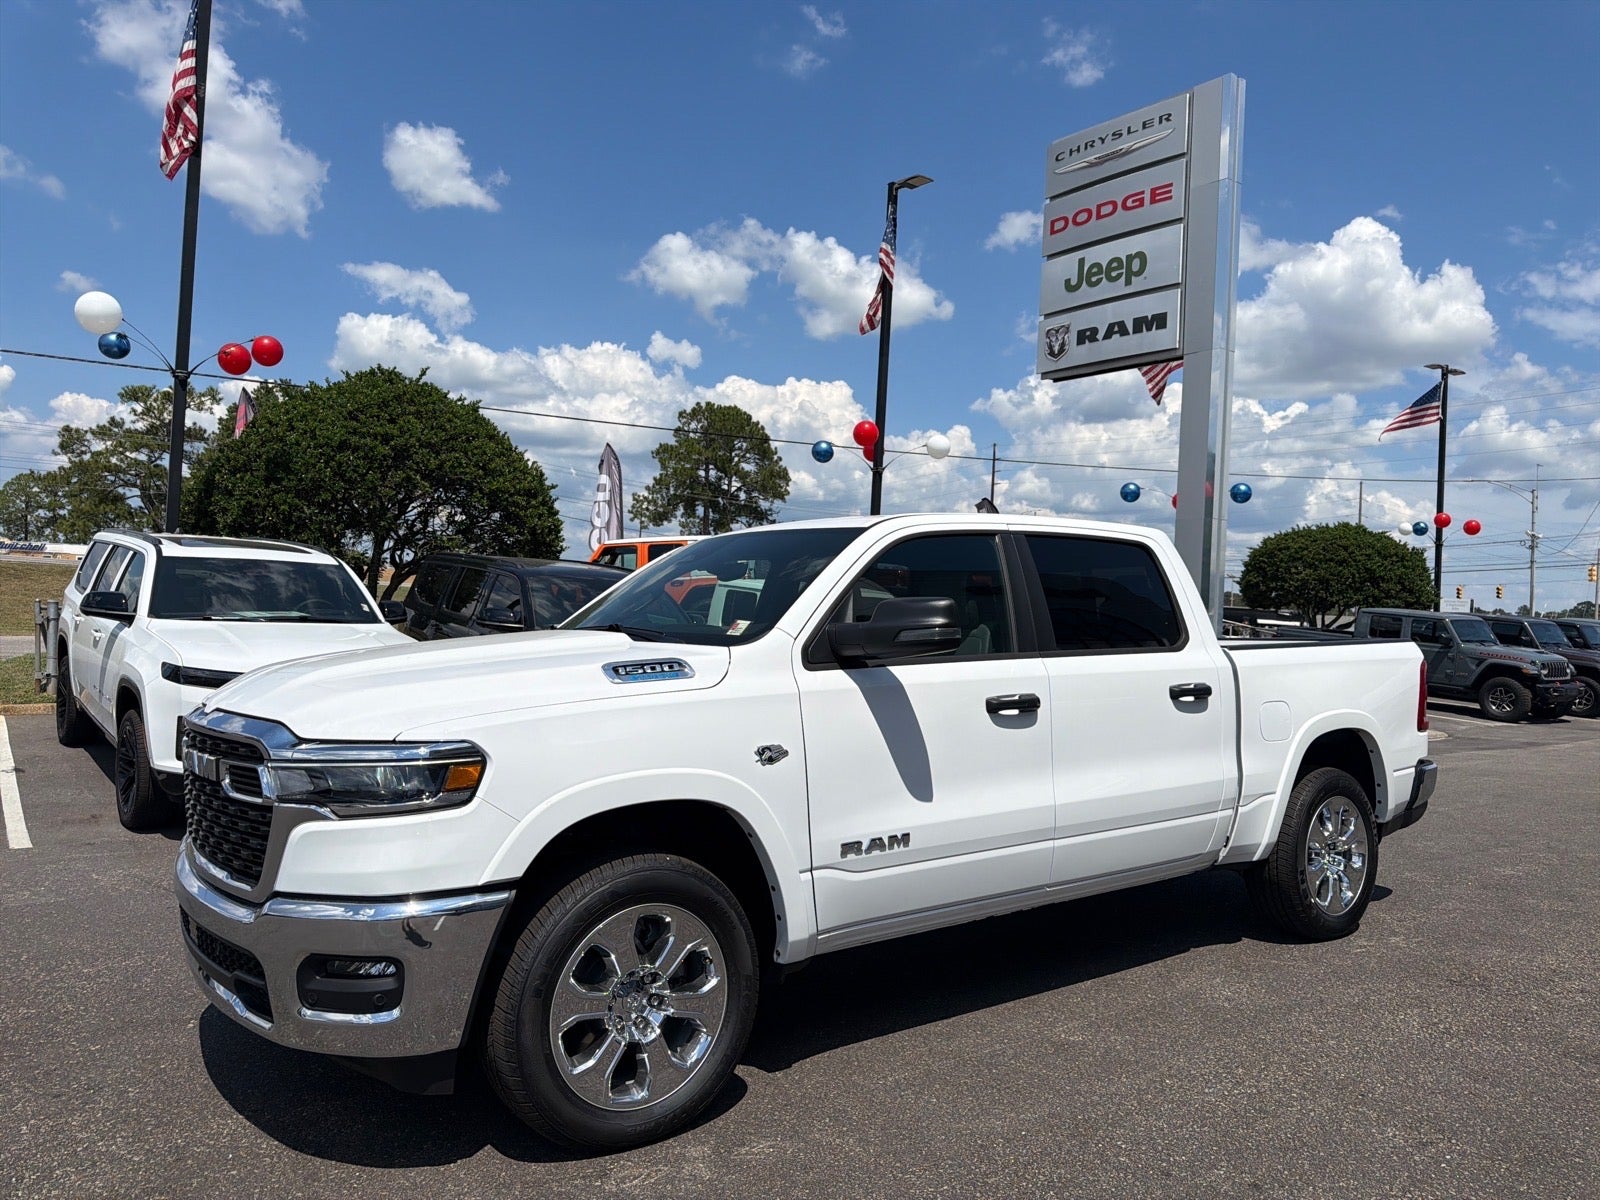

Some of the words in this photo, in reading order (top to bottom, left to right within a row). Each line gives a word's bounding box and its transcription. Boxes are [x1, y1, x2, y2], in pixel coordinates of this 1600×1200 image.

[1055, 112, 1173, 162] CHRYSLER
[1050, 182, 1174, 236] DODGE
[1064, 251, 1148, 293] Jeep
[1076, 312, 1168, 346] RAM
[617, 663, 681, 676] 1500
[840, 832, 911, 859] RAM
